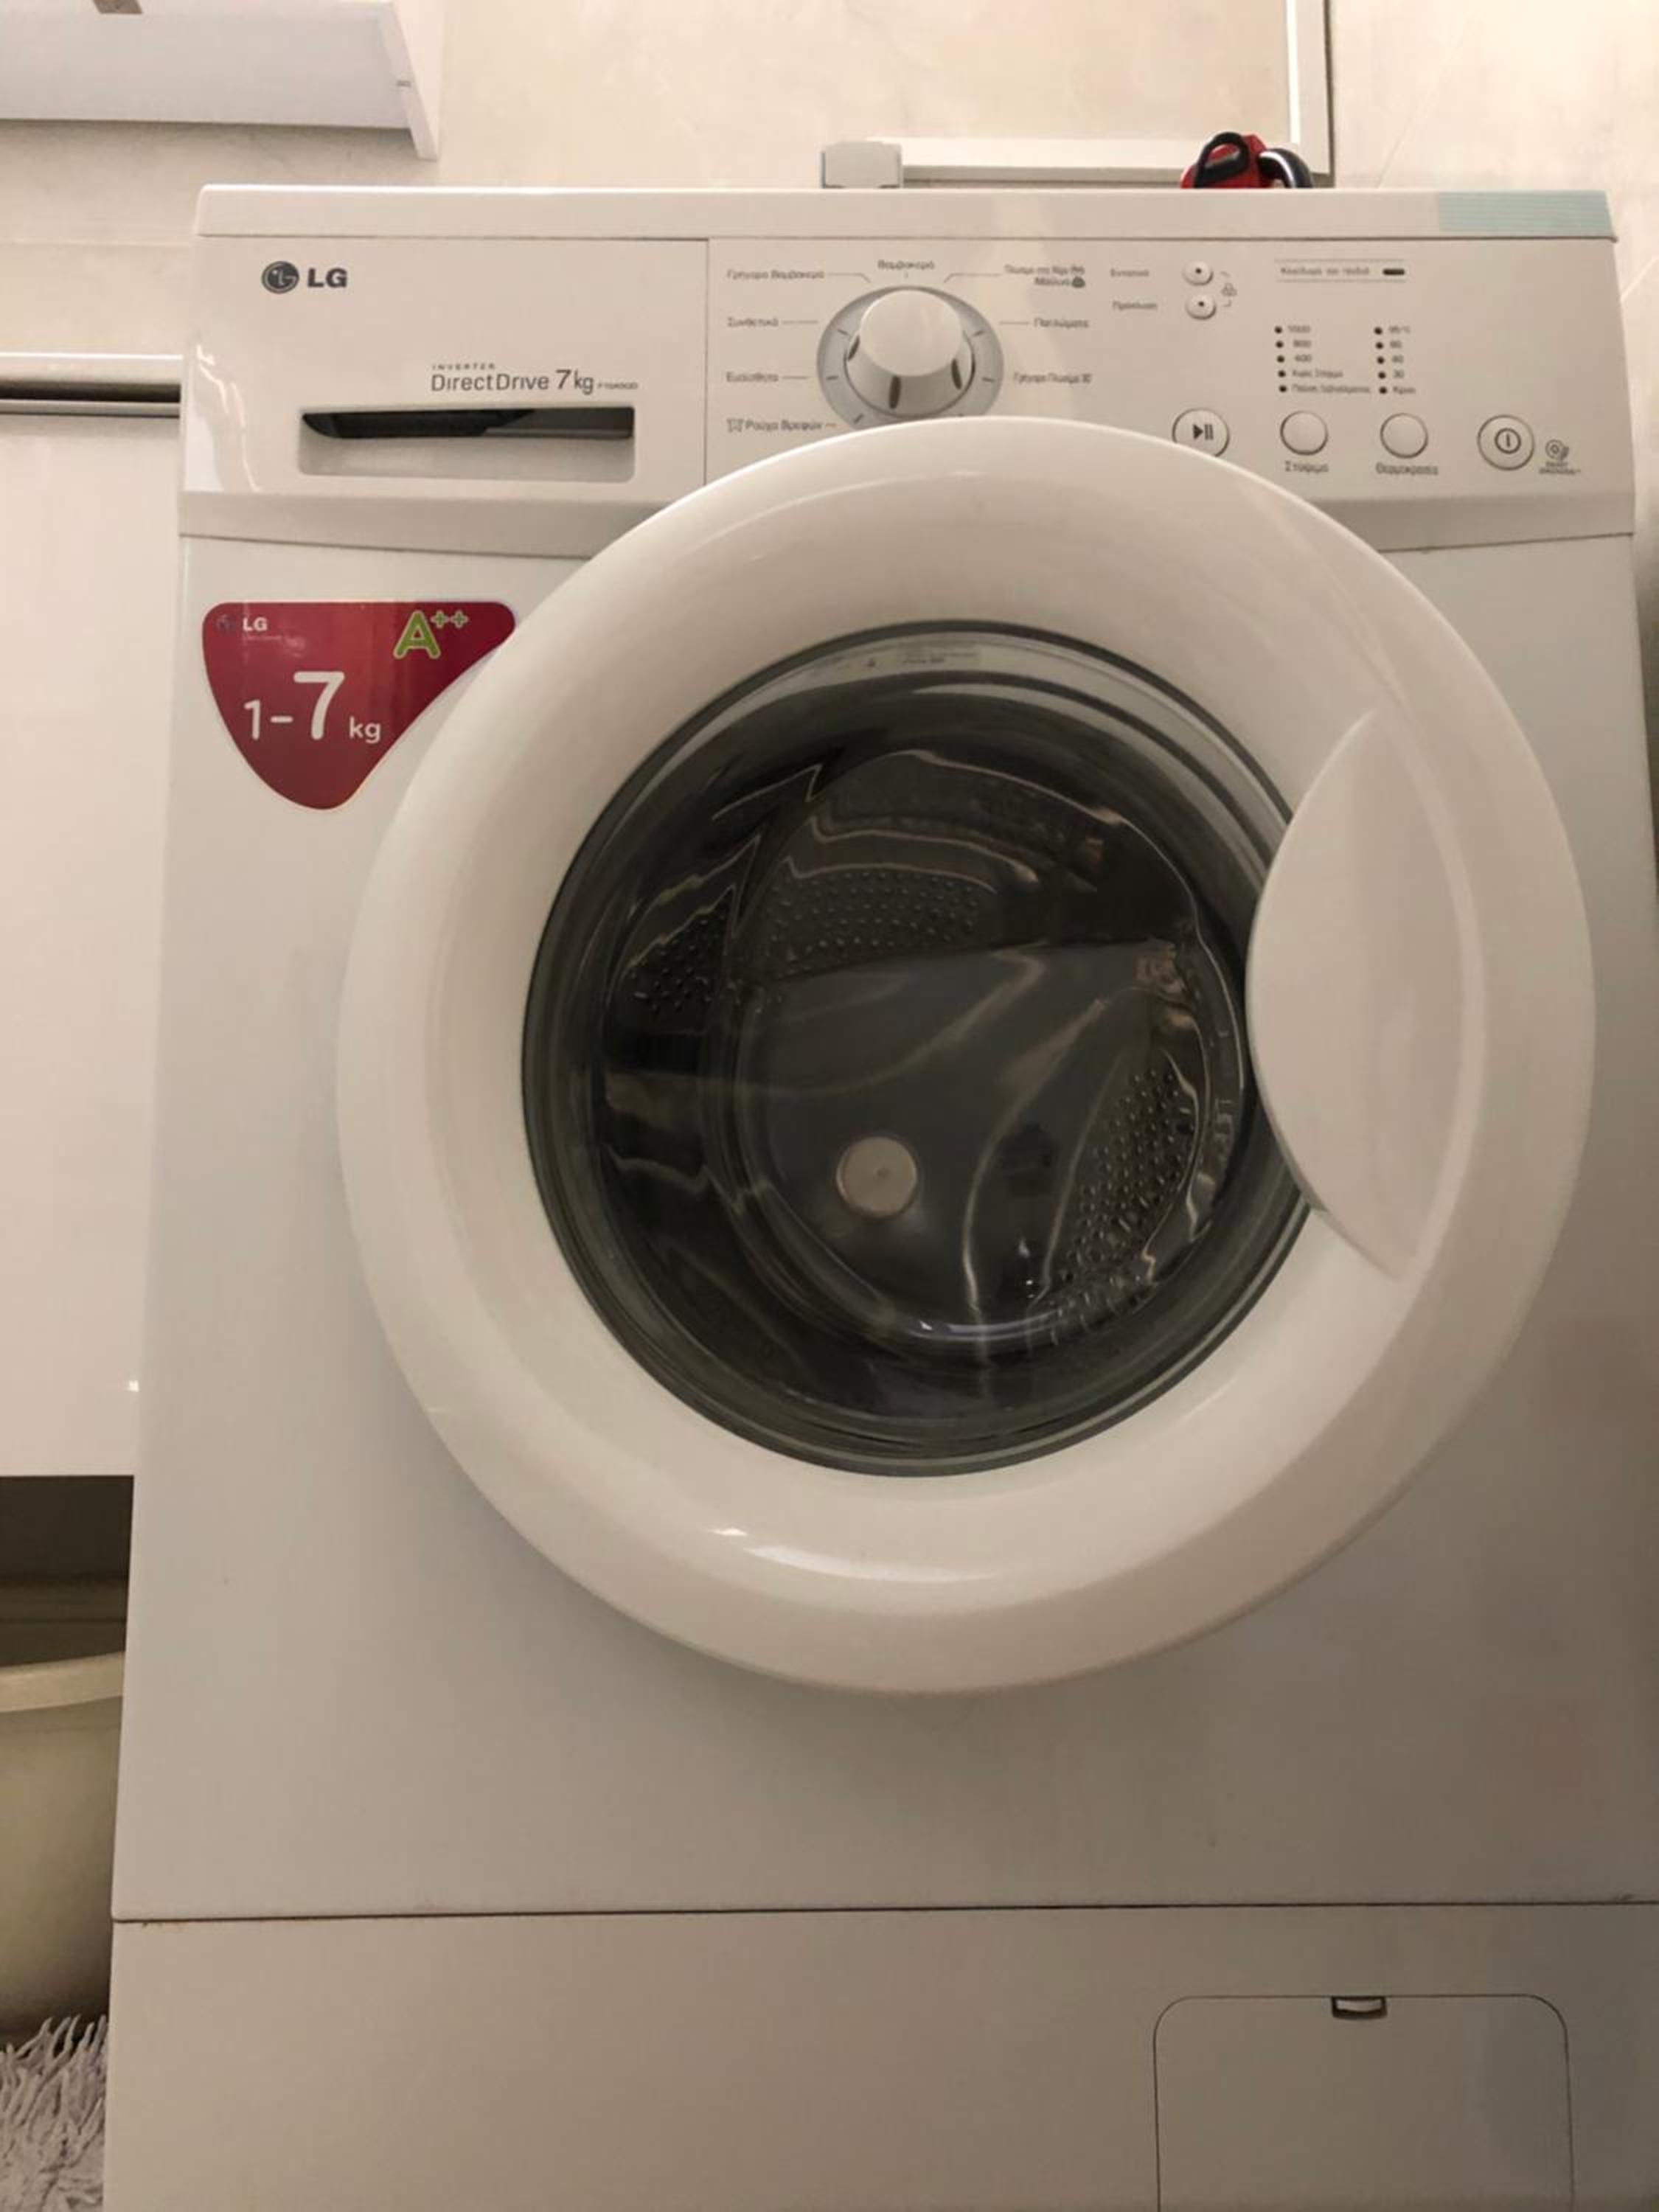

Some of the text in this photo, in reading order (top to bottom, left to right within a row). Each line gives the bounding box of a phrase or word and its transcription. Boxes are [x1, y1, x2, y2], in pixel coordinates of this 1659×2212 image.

[307, 268, 348, 288] LG
[555, 369, 572, 390] 7
[574, 369, 594, 396] kg
[243, 616, 269, 632] LG
[348, 715, 382, 744] kg
